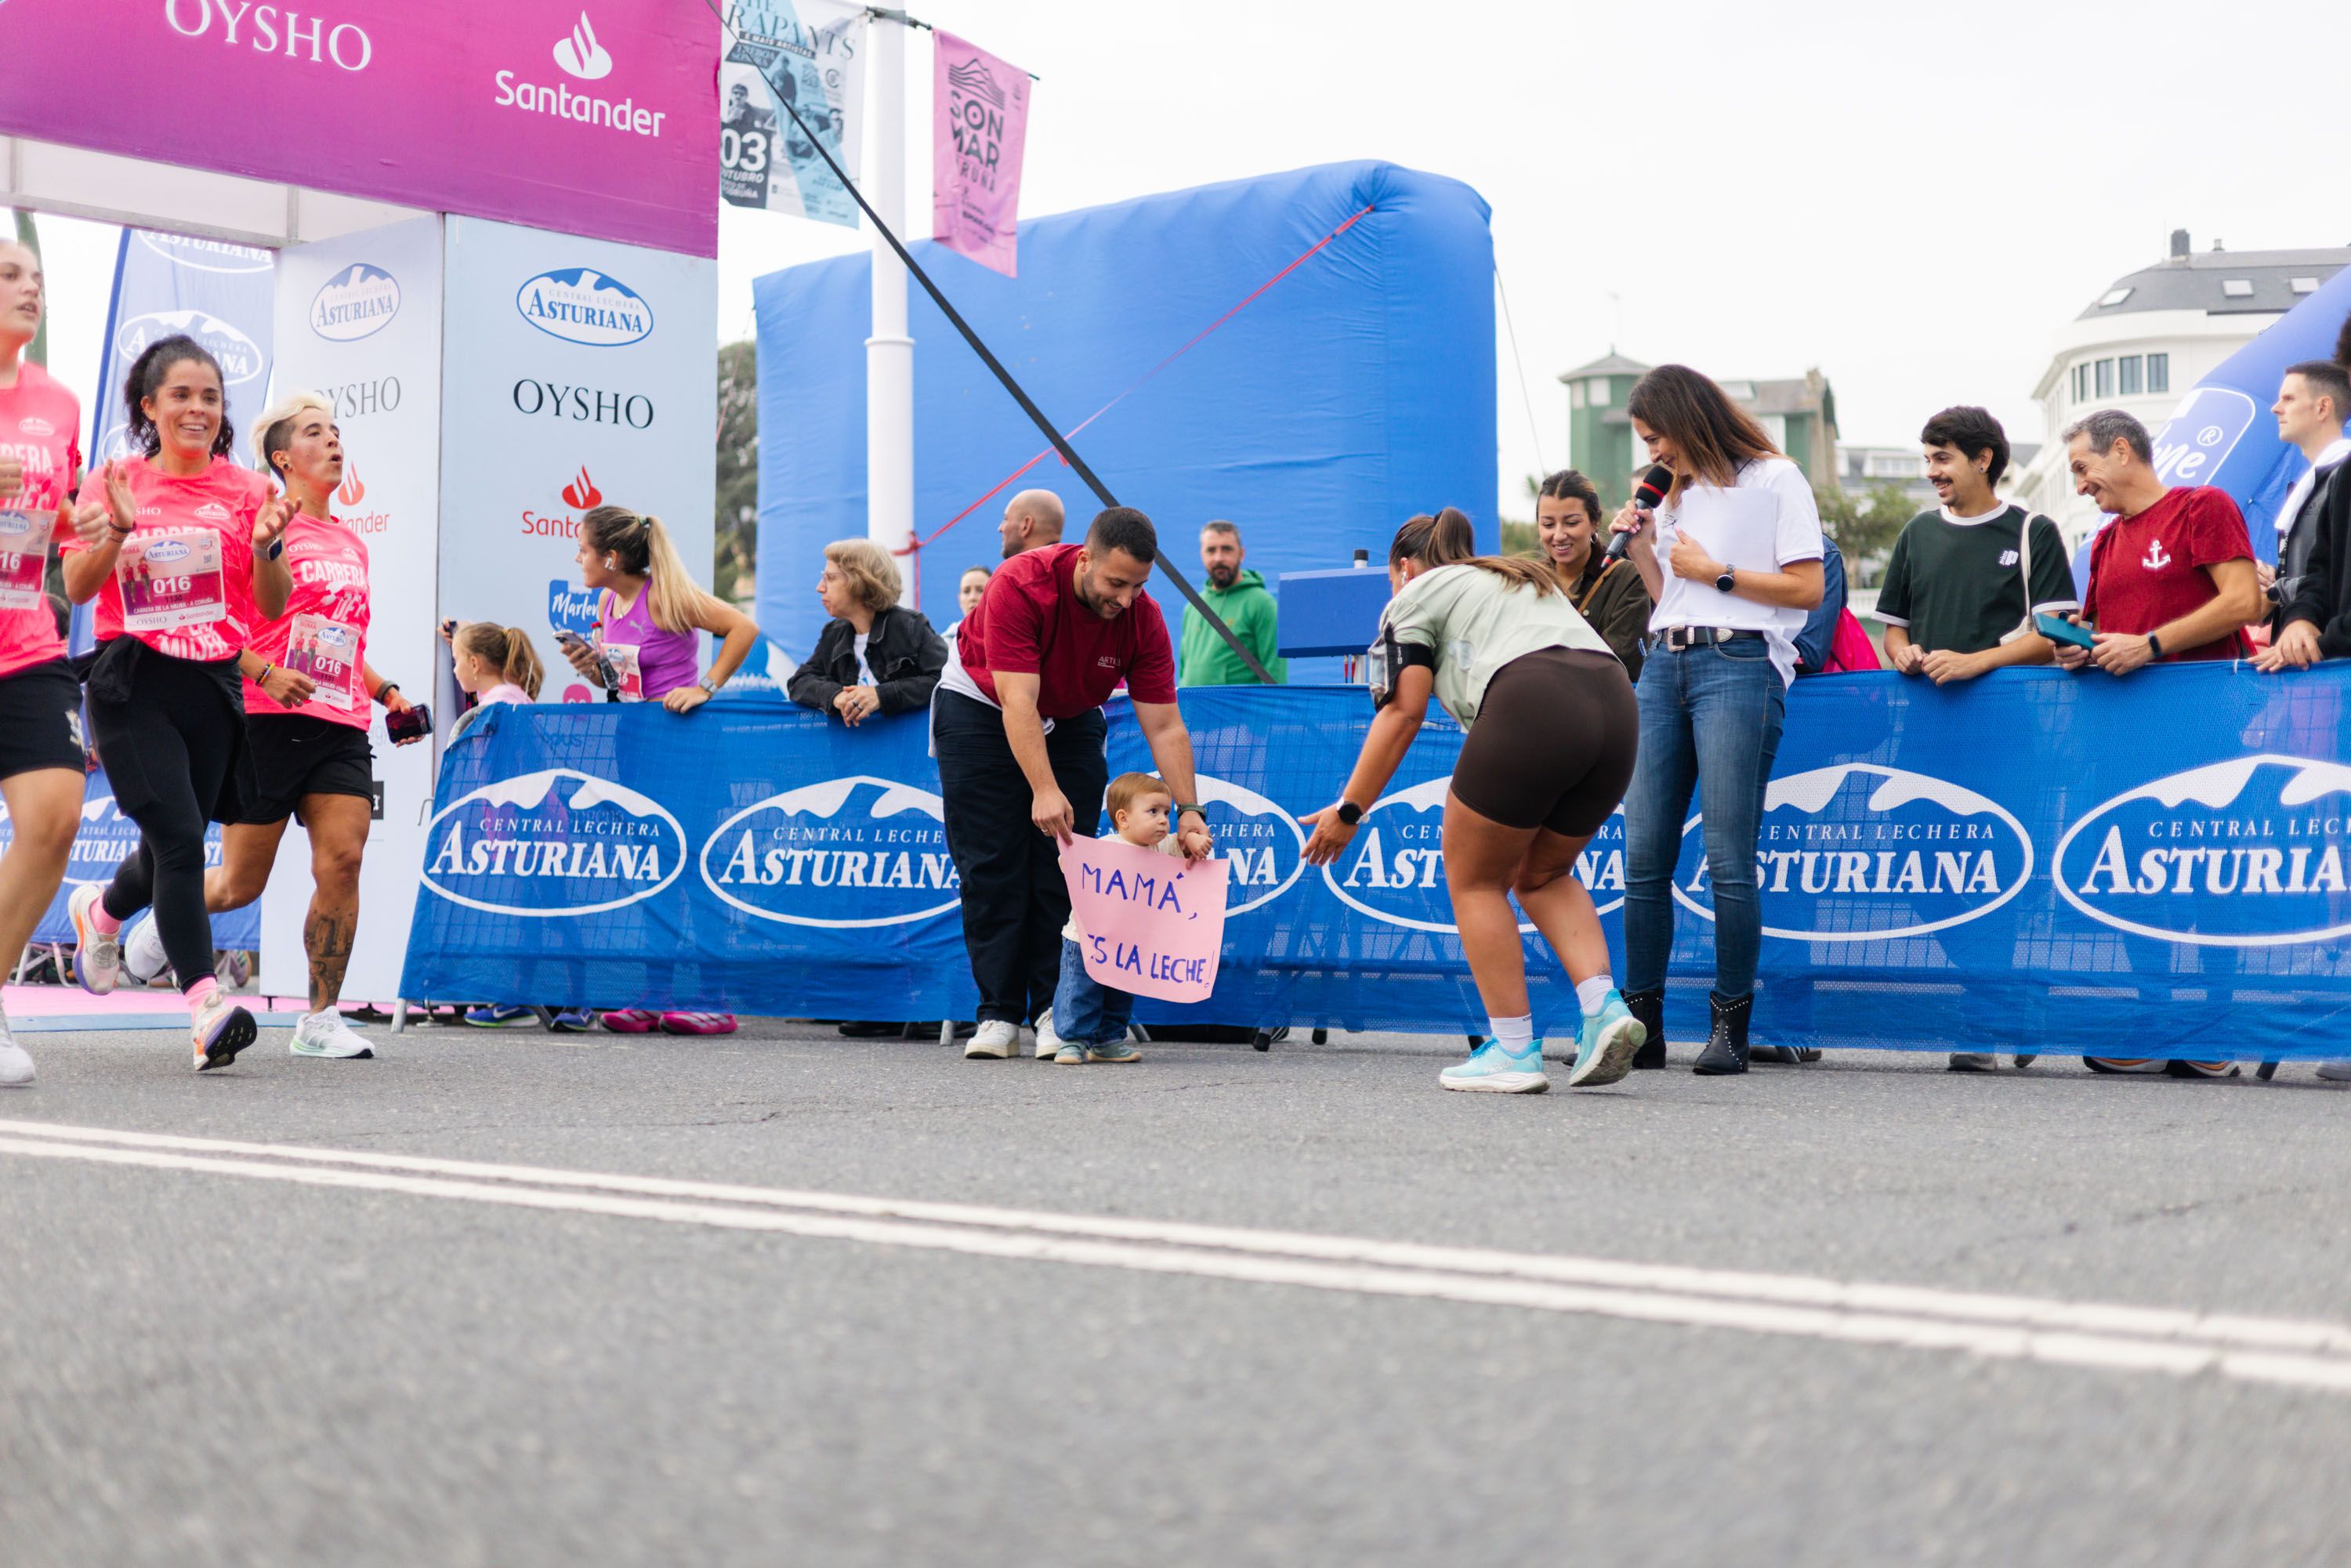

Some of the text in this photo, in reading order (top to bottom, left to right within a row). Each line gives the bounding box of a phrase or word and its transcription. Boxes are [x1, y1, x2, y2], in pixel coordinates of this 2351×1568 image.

[165, 0, 371, 71] OYSHO
[495, 70, 666, 137] Santander
[721, 128, 767, 172] 03
[316, 294, 394, 328] ASTURIANA
[527, 287, 644, 334] ASTURIANA
[549, 288, 593, 303] CENTRAL
[313, 376, 402, 420] YSHO
[513, 378, 654, 429] OYSHO
[135, 507, 161, 516] SHO
[147, 549, 188, 559] ASTURIANA
[153, 576, 192, 595] 016
[300, 559, 368, 592] CARRERA
[136, 610, 214, 626] OYSHO Santander
[315, 656, 342, 675] 016
[480, 817, 661, 837] CENTRAL LECHERA
[773, 827, 944, 844] CENTRAL LECHE
[1756, 824, 1994, 841] ENTRAL LECHERA
[2149, 820, 2275, 838] CENTRAL
[428, 820, 661, 882] ASTURIANA
[2078, 824, 2351, 895] ASTURIA
[1115, 943, 1143, 976] LA
